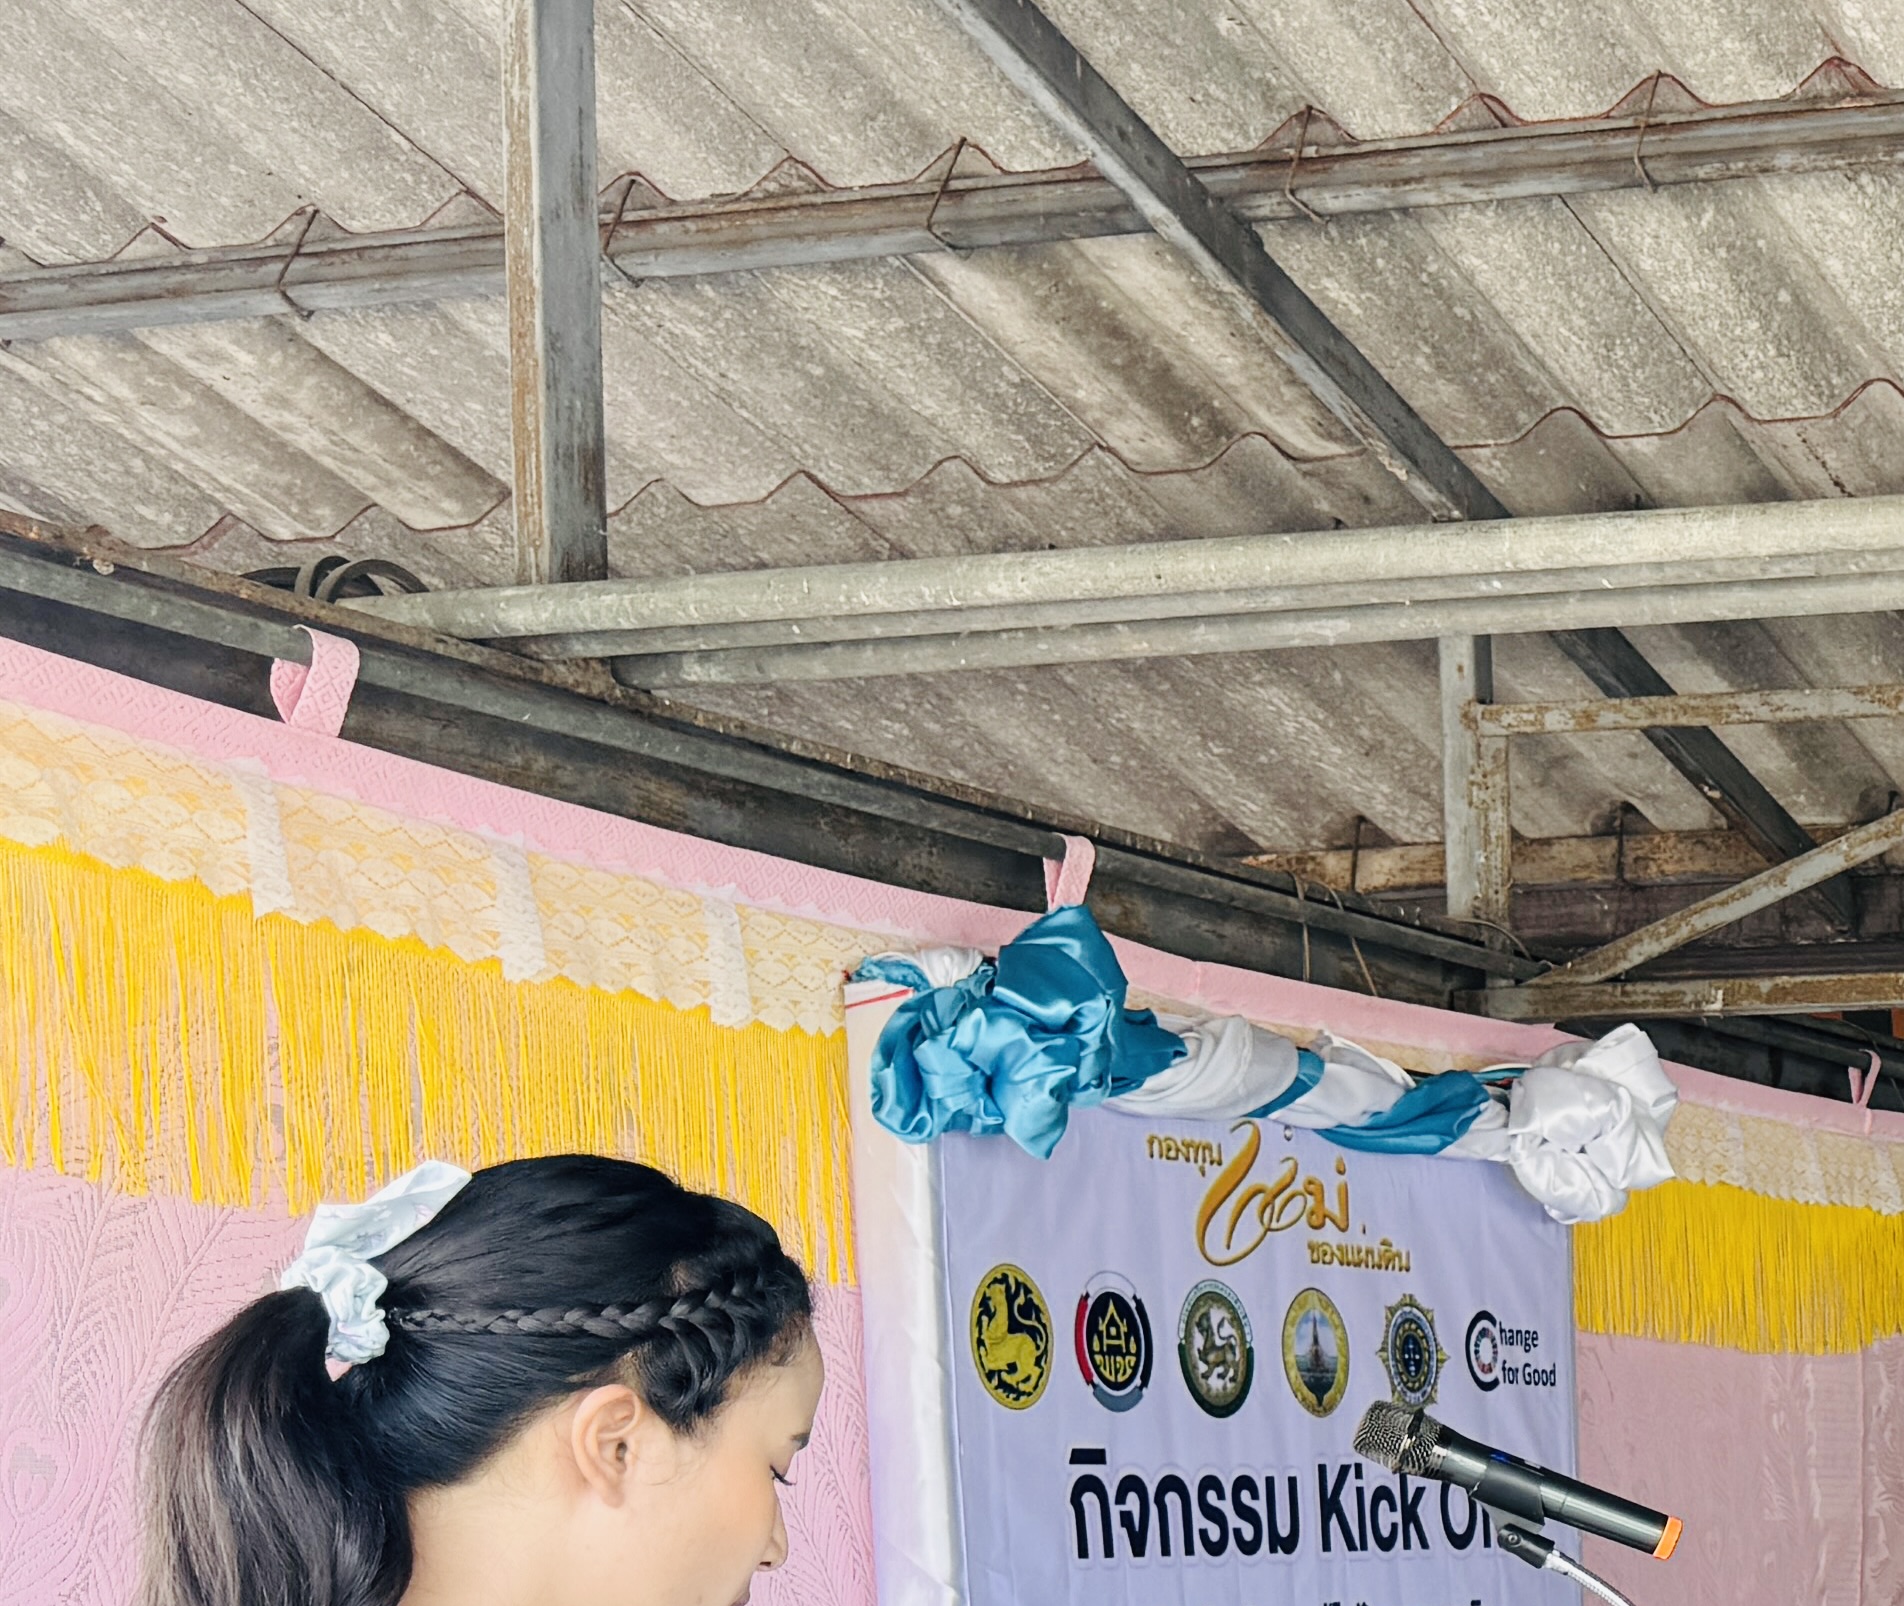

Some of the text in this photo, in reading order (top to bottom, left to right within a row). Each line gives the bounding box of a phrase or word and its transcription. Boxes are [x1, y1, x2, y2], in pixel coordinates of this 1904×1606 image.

[1147, 1134, 1224, 1178] กองทุน
[1501, 1362, 1557, 1388] for Good
[1068, 1447, 1300, 1560] กิจกรรม
[1317, 1461, 1431, 1553] Kick
